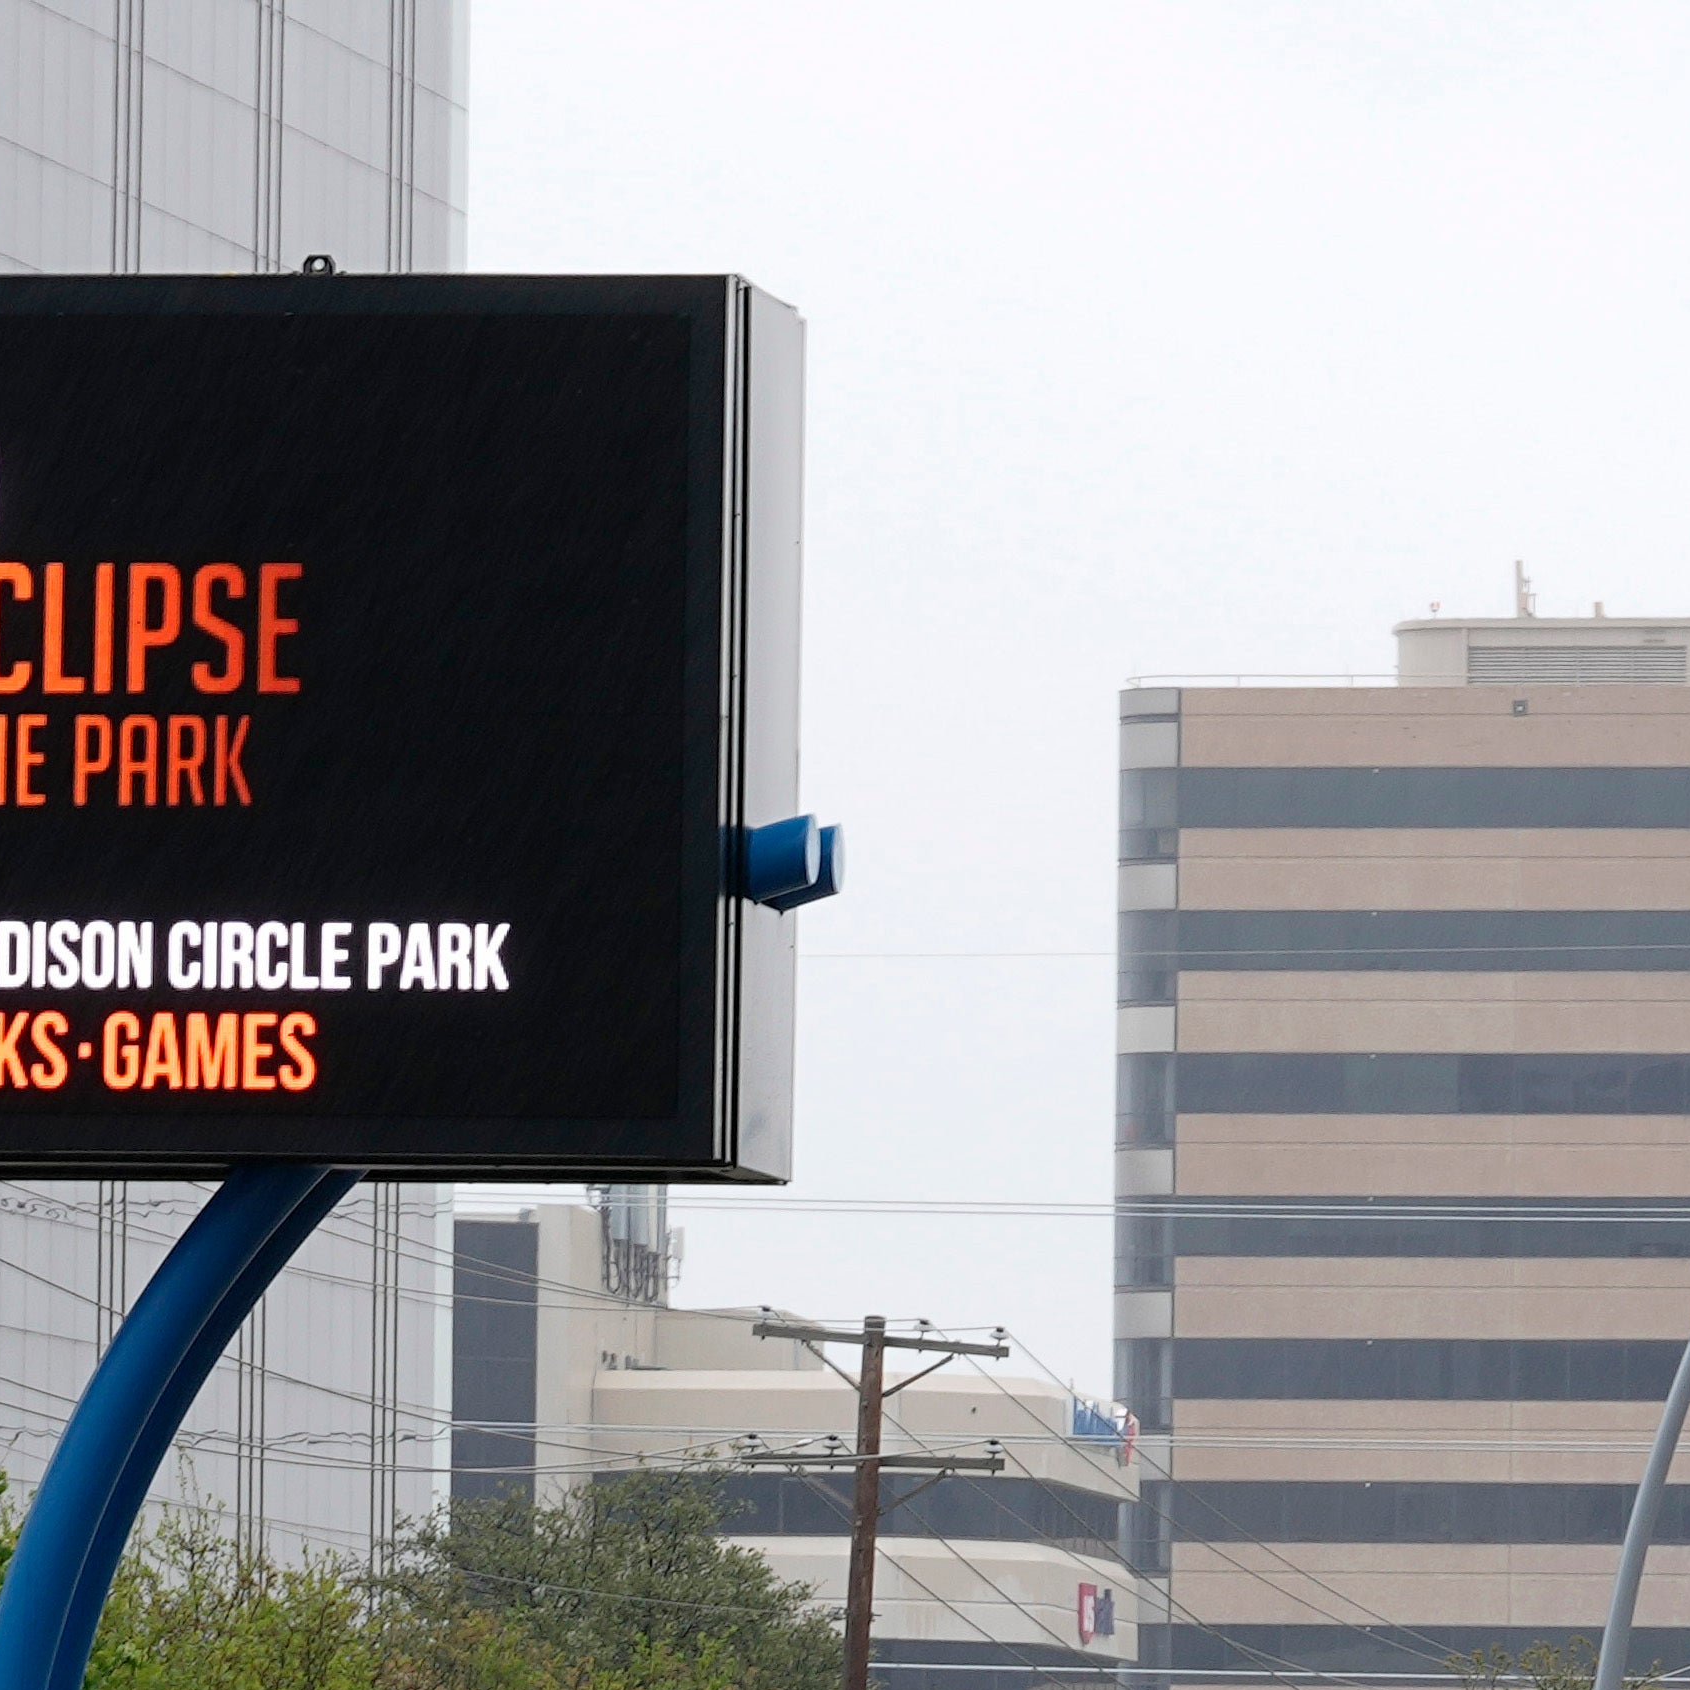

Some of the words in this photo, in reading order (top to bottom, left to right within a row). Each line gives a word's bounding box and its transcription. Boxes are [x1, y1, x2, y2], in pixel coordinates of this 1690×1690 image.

[71, 711, 254, 808] PARK
[166, 918, 354, 992] CIRCLE
[365, 920, 512, 993] PARK
[100, 1008, 320, 1094] GAMES
